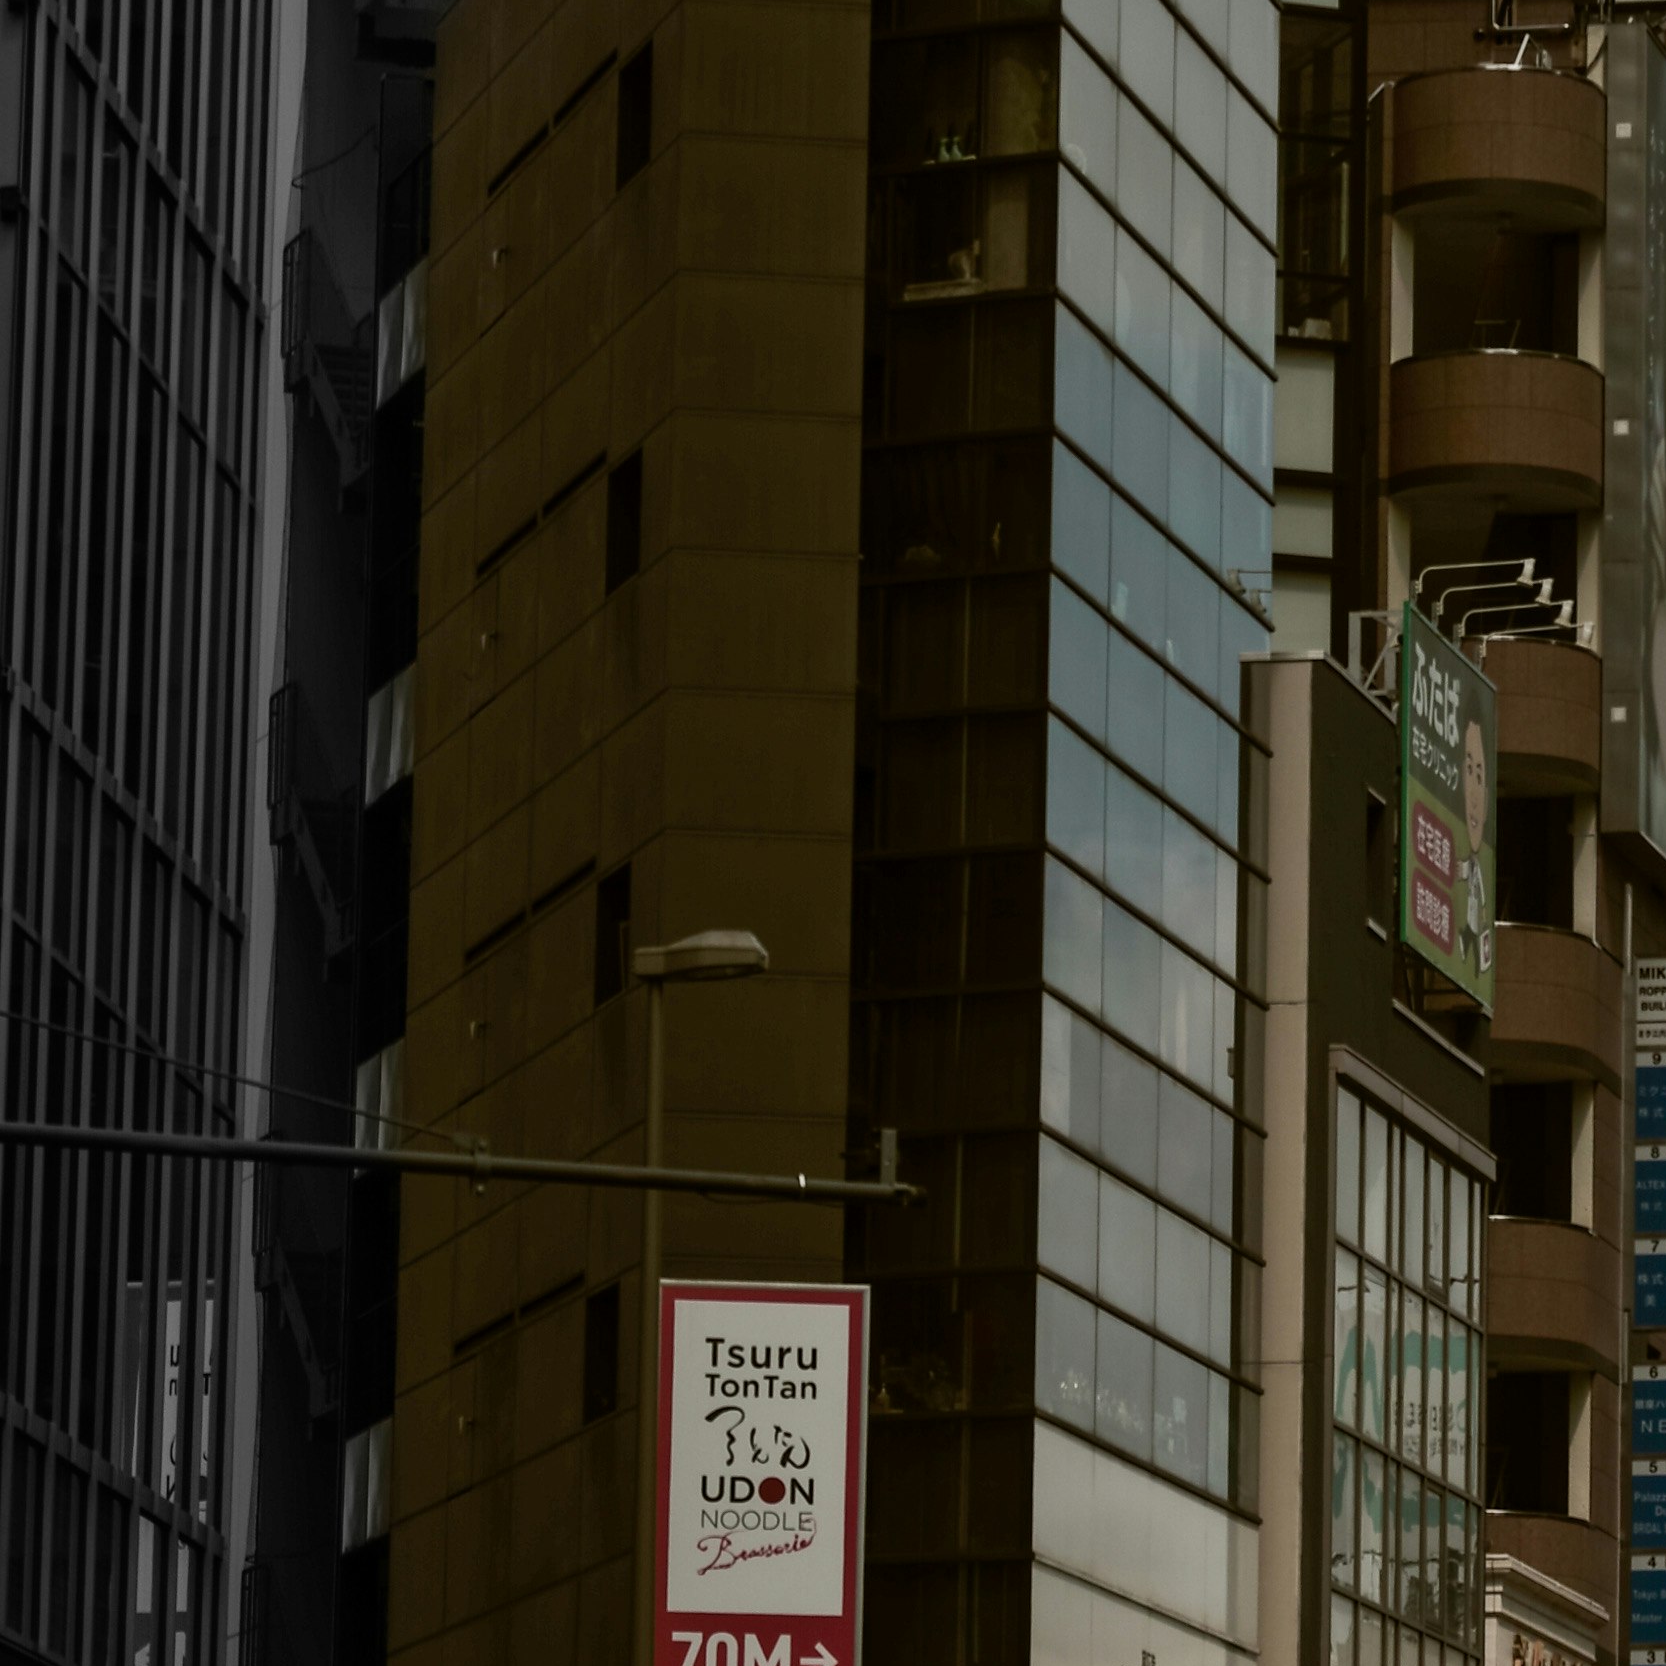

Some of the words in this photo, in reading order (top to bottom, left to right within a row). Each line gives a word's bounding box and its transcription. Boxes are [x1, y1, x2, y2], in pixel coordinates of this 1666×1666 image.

[1412, 641, 1460, 748] ふたば
[1411, 726, 1459, 792] 在宅クリニック
[706, 1337, 818, 1370] Tsuru
[705, 1373, 817, 1400] TonTan
[701, 1510, 814, 1532] NOODLE
